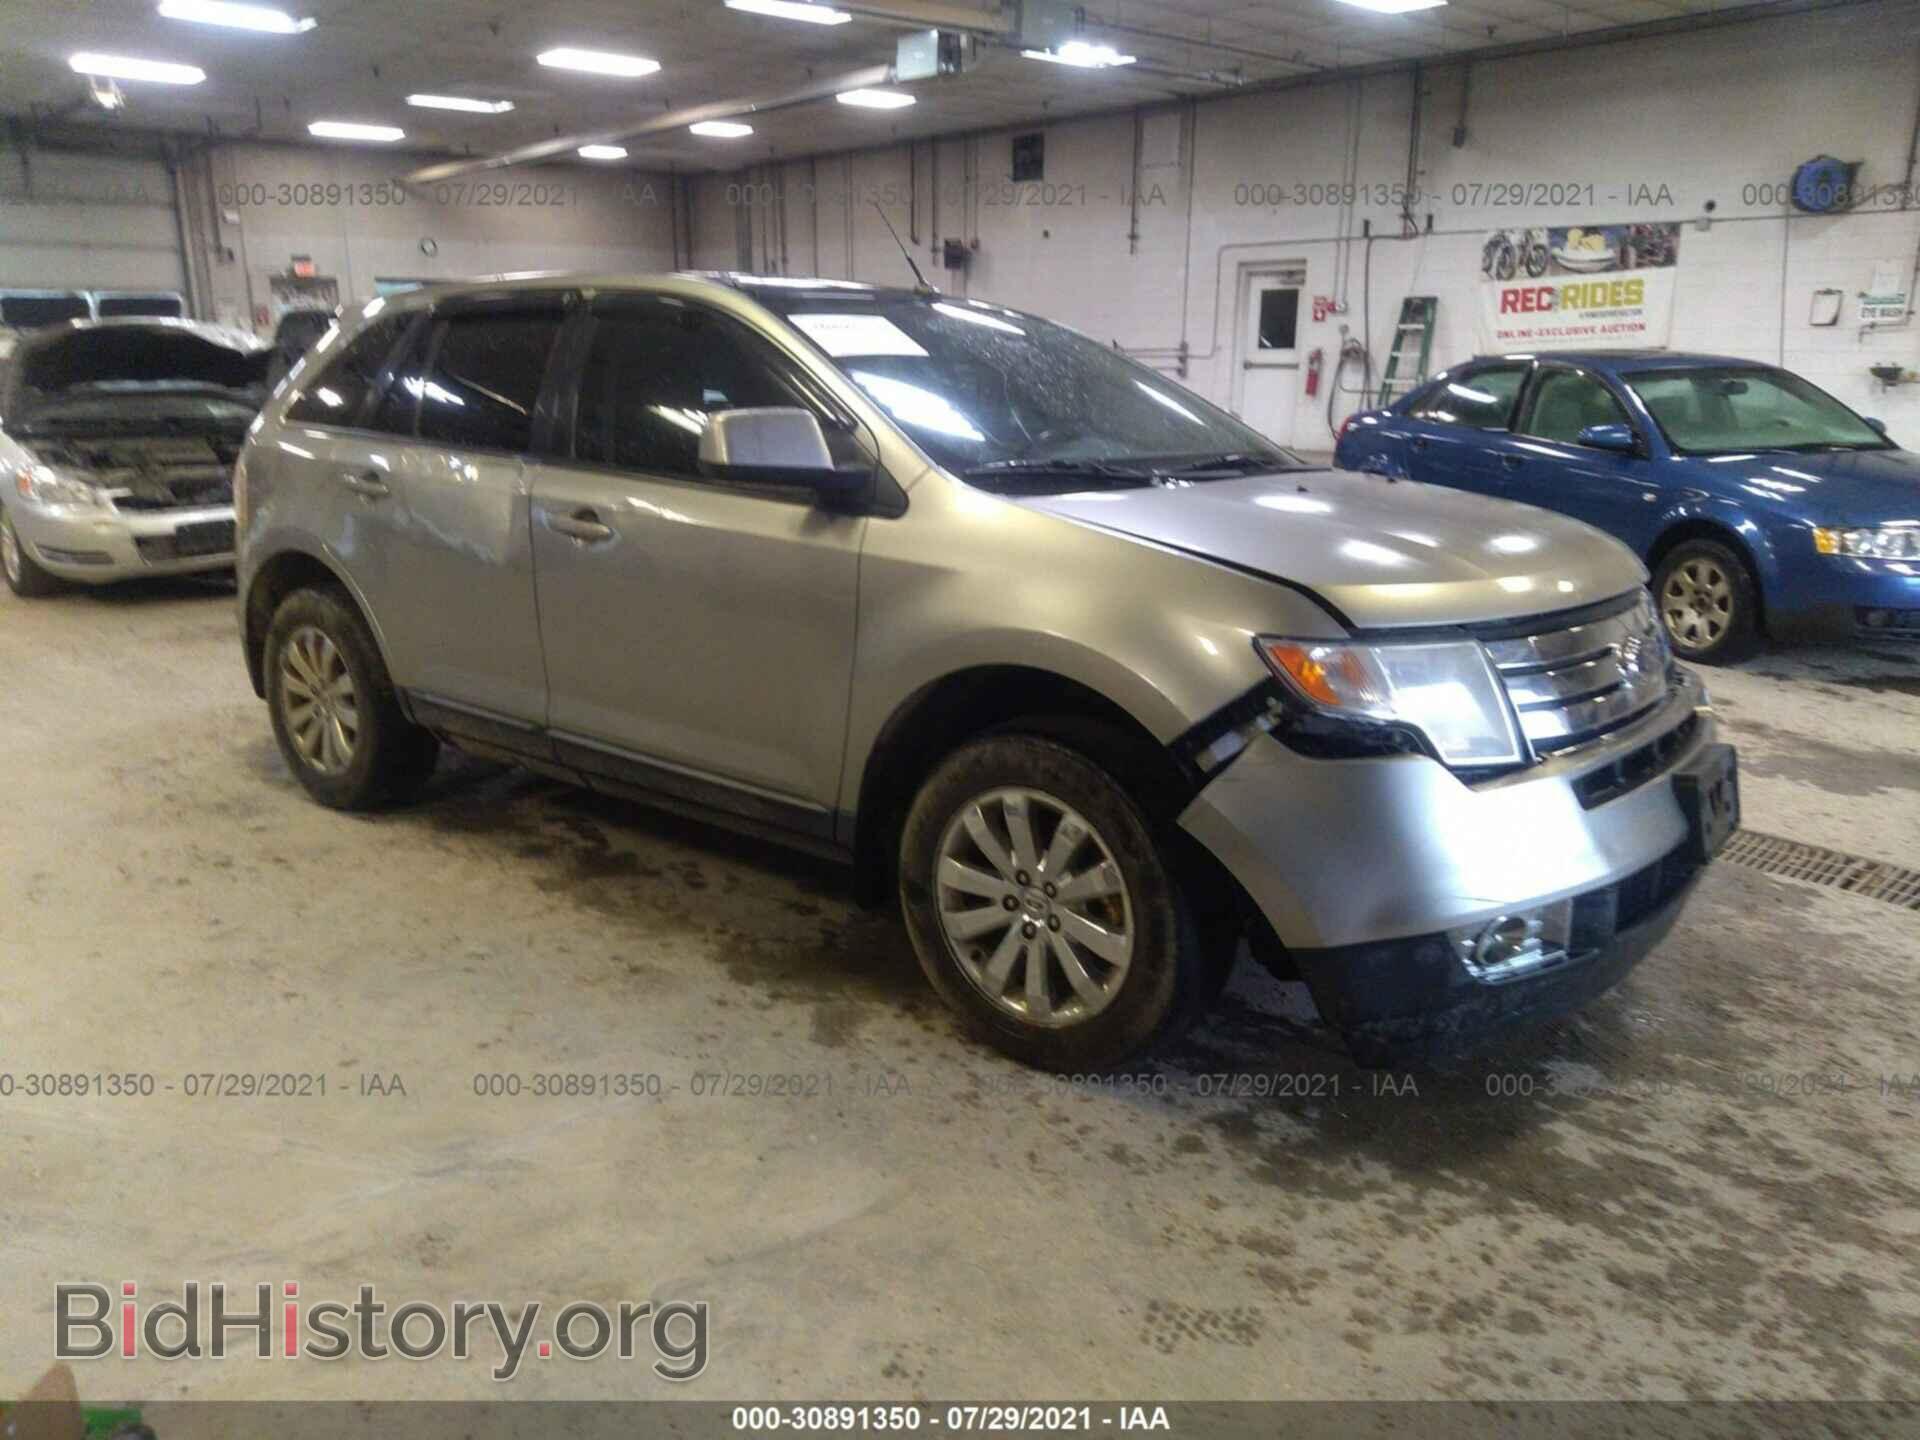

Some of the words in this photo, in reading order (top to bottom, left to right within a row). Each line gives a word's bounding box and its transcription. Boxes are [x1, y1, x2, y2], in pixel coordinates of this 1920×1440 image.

[1502, 286, 1554, 314] REC
[1561, 278, 1645, 310] RIDES
[1600, 322, 1646, 334] AUCTION
